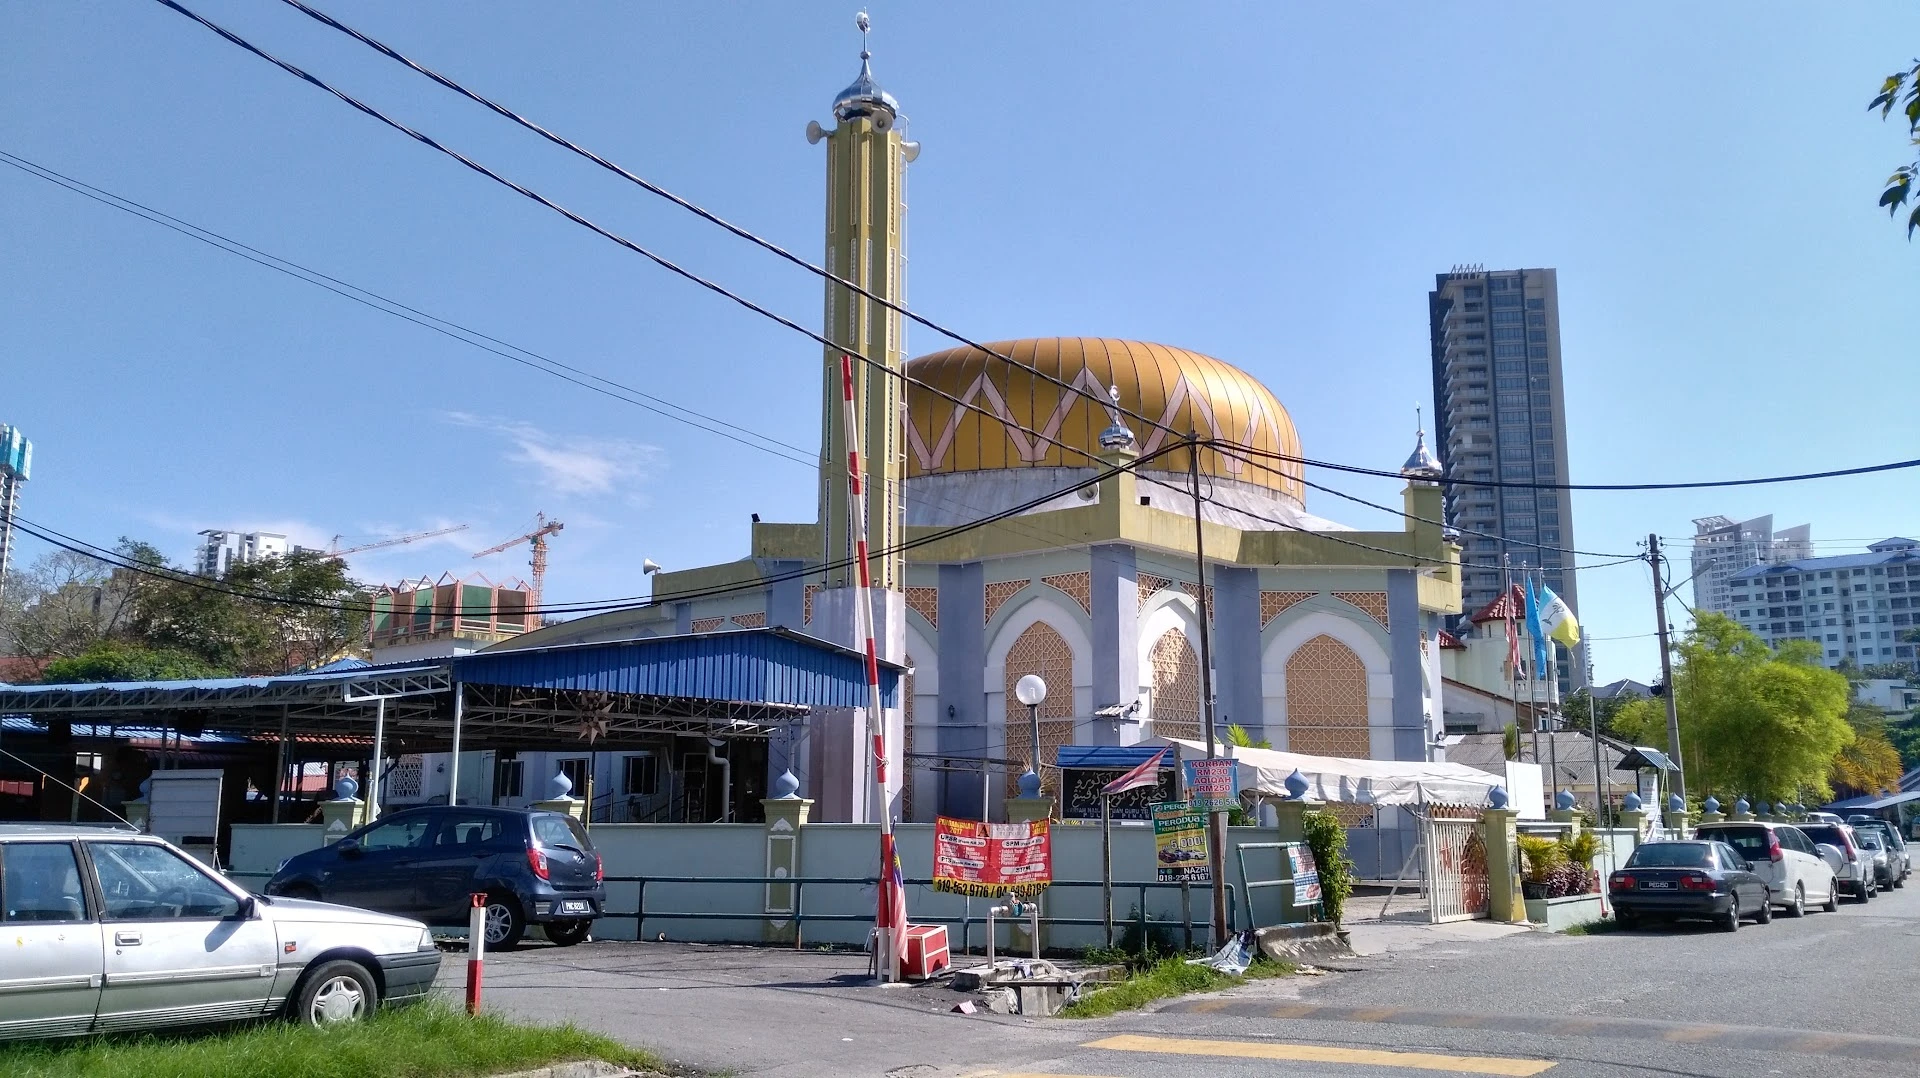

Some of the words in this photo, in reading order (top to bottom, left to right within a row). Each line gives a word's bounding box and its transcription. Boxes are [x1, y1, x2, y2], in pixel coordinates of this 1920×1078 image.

[1191, 760, 1232, 768] KORBAN
[1188, 799, 1202, 807] 019
[1204, 799, 1223, 807] 2626
[970, 884, 989, 898] 9776
